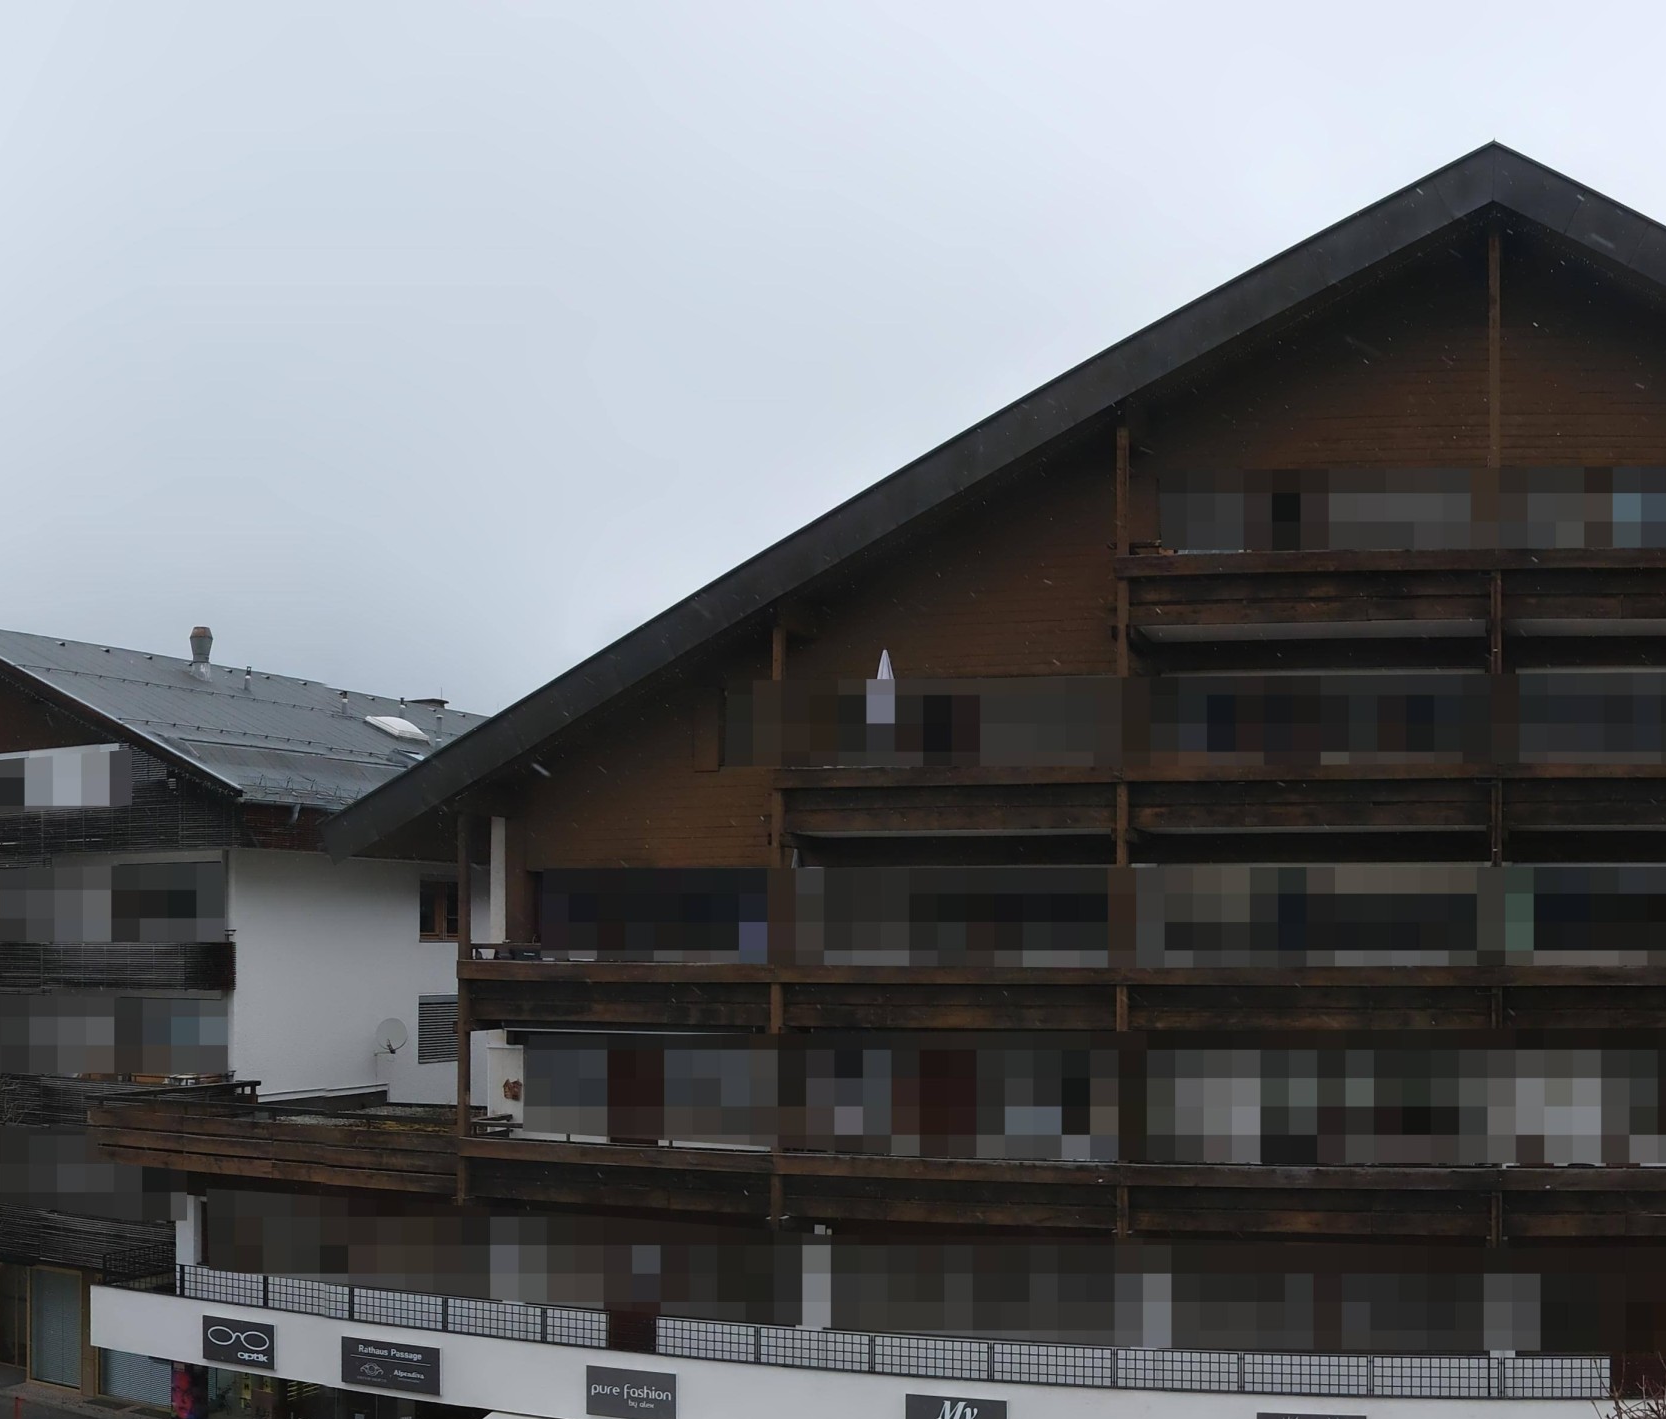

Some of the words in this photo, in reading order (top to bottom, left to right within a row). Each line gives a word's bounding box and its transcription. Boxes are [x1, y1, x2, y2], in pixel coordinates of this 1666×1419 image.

[237, 1350, 268, 1363] optik
[358, 1344, 388, 1356] Rathaus
[390, 1348, 422, 1361] Passage
[591, 1384, 620, 1396] pure
[623, 1383, 672, 1401] fashion
[628, 1399, 637, 1408] by
